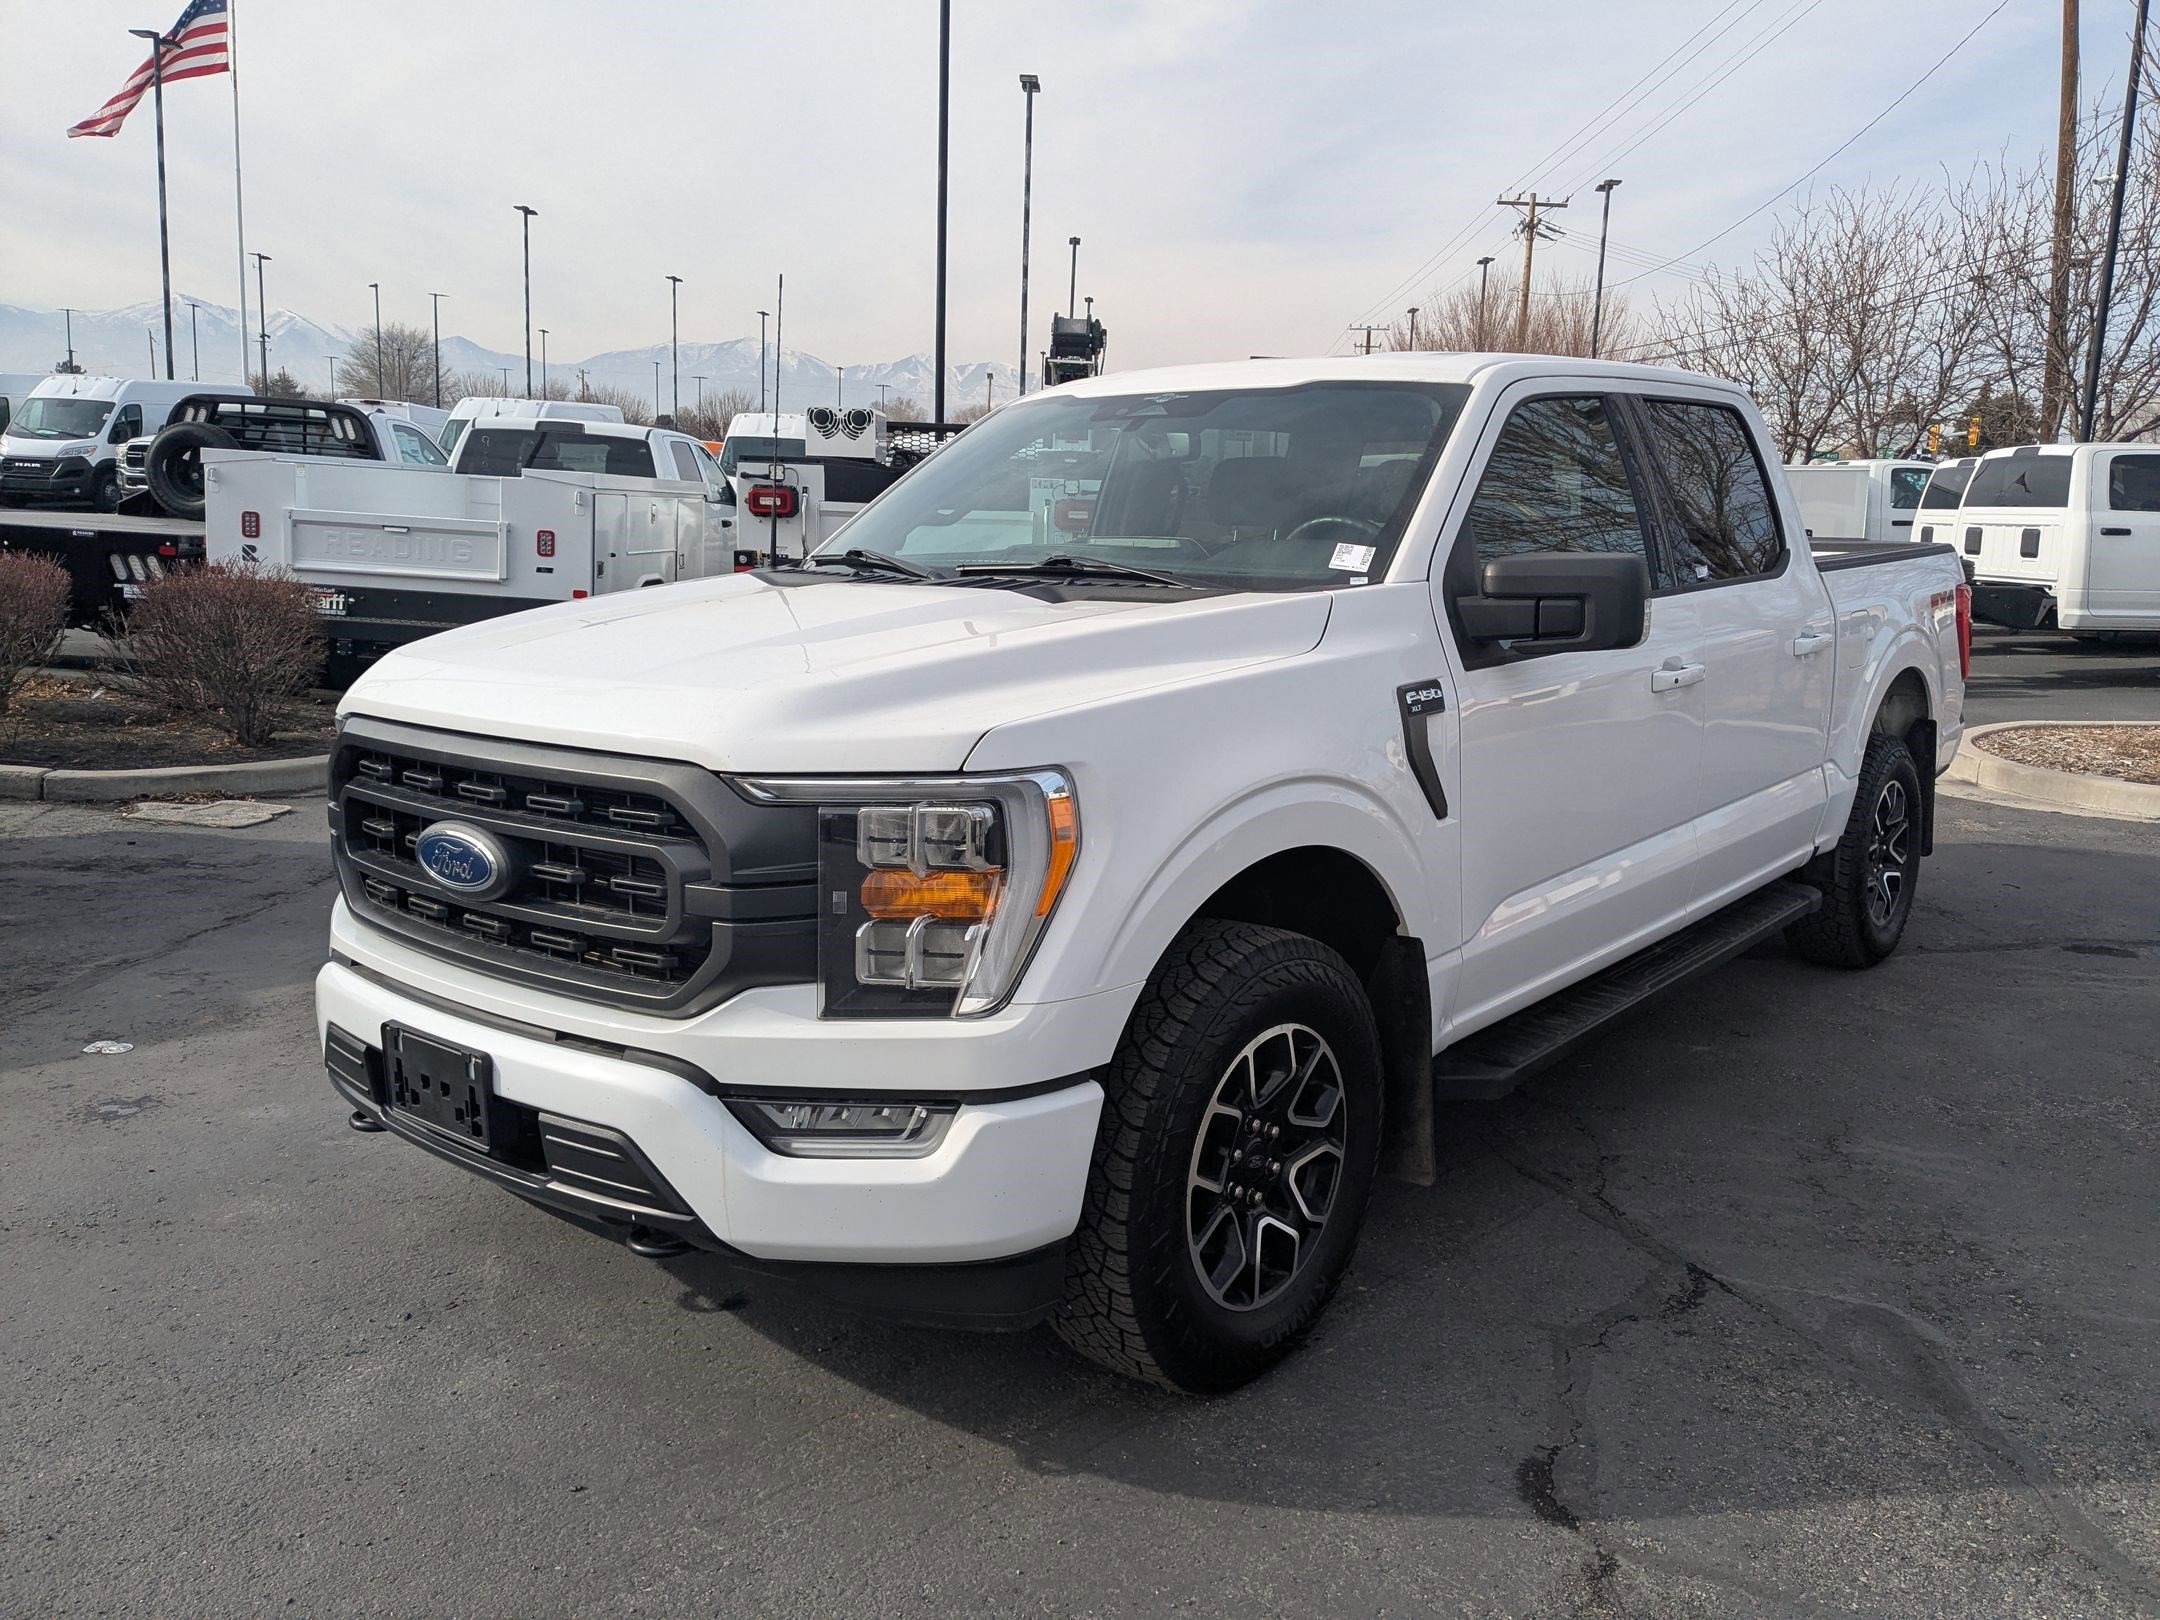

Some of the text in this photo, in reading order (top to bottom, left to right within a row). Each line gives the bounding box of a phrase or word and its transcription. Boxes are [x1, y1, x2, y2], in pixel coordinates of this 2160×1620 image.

[324, 530, 474, 564] READING
[1406, 688, 1442, 704] F-150
[1411, 704, 1422, 712] XLT
[430, 841, 474, 880] Ford
